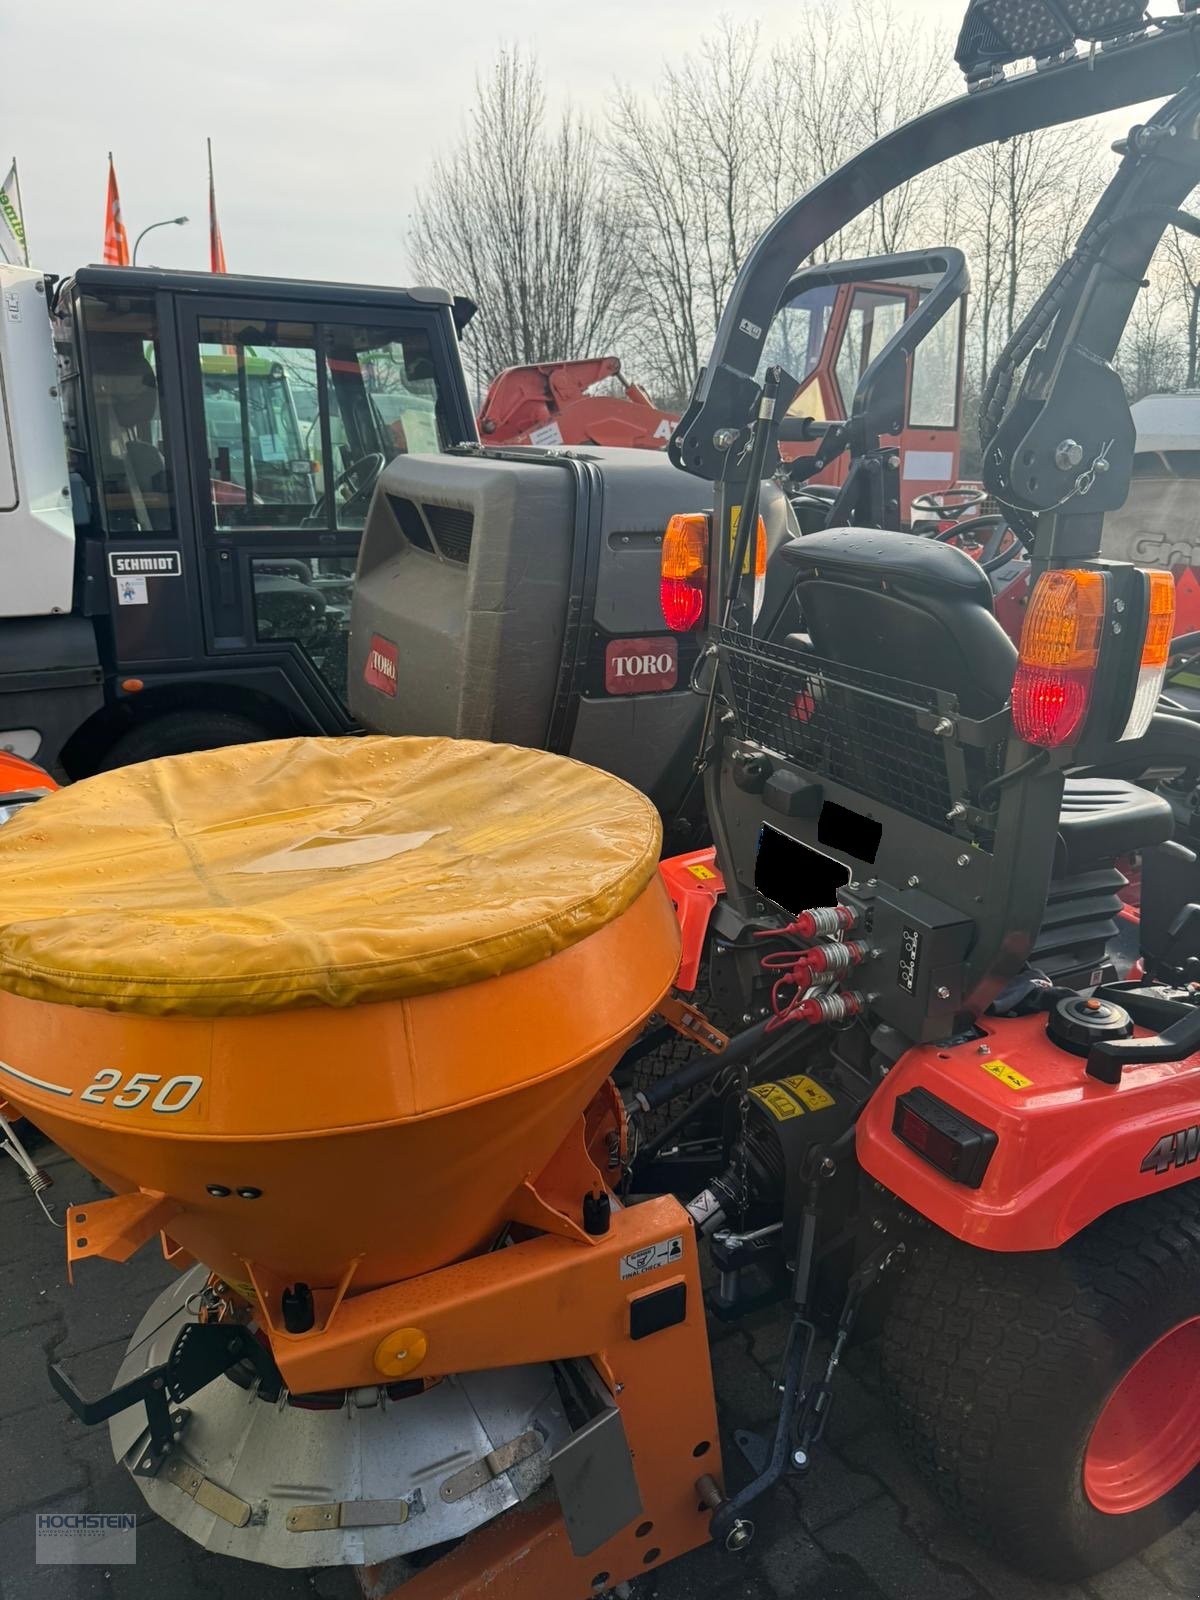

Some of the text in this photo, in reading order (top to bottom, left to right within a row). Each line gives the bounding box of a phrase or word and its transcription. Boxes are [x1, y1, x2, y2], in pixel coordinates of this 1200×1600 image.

[116, 557, 173, 571] SCHMIDT
[370, 649, 396, 680] TORO
[611, 653, 674, 677] TORO
[80, 1068, 203, 1113] 250
